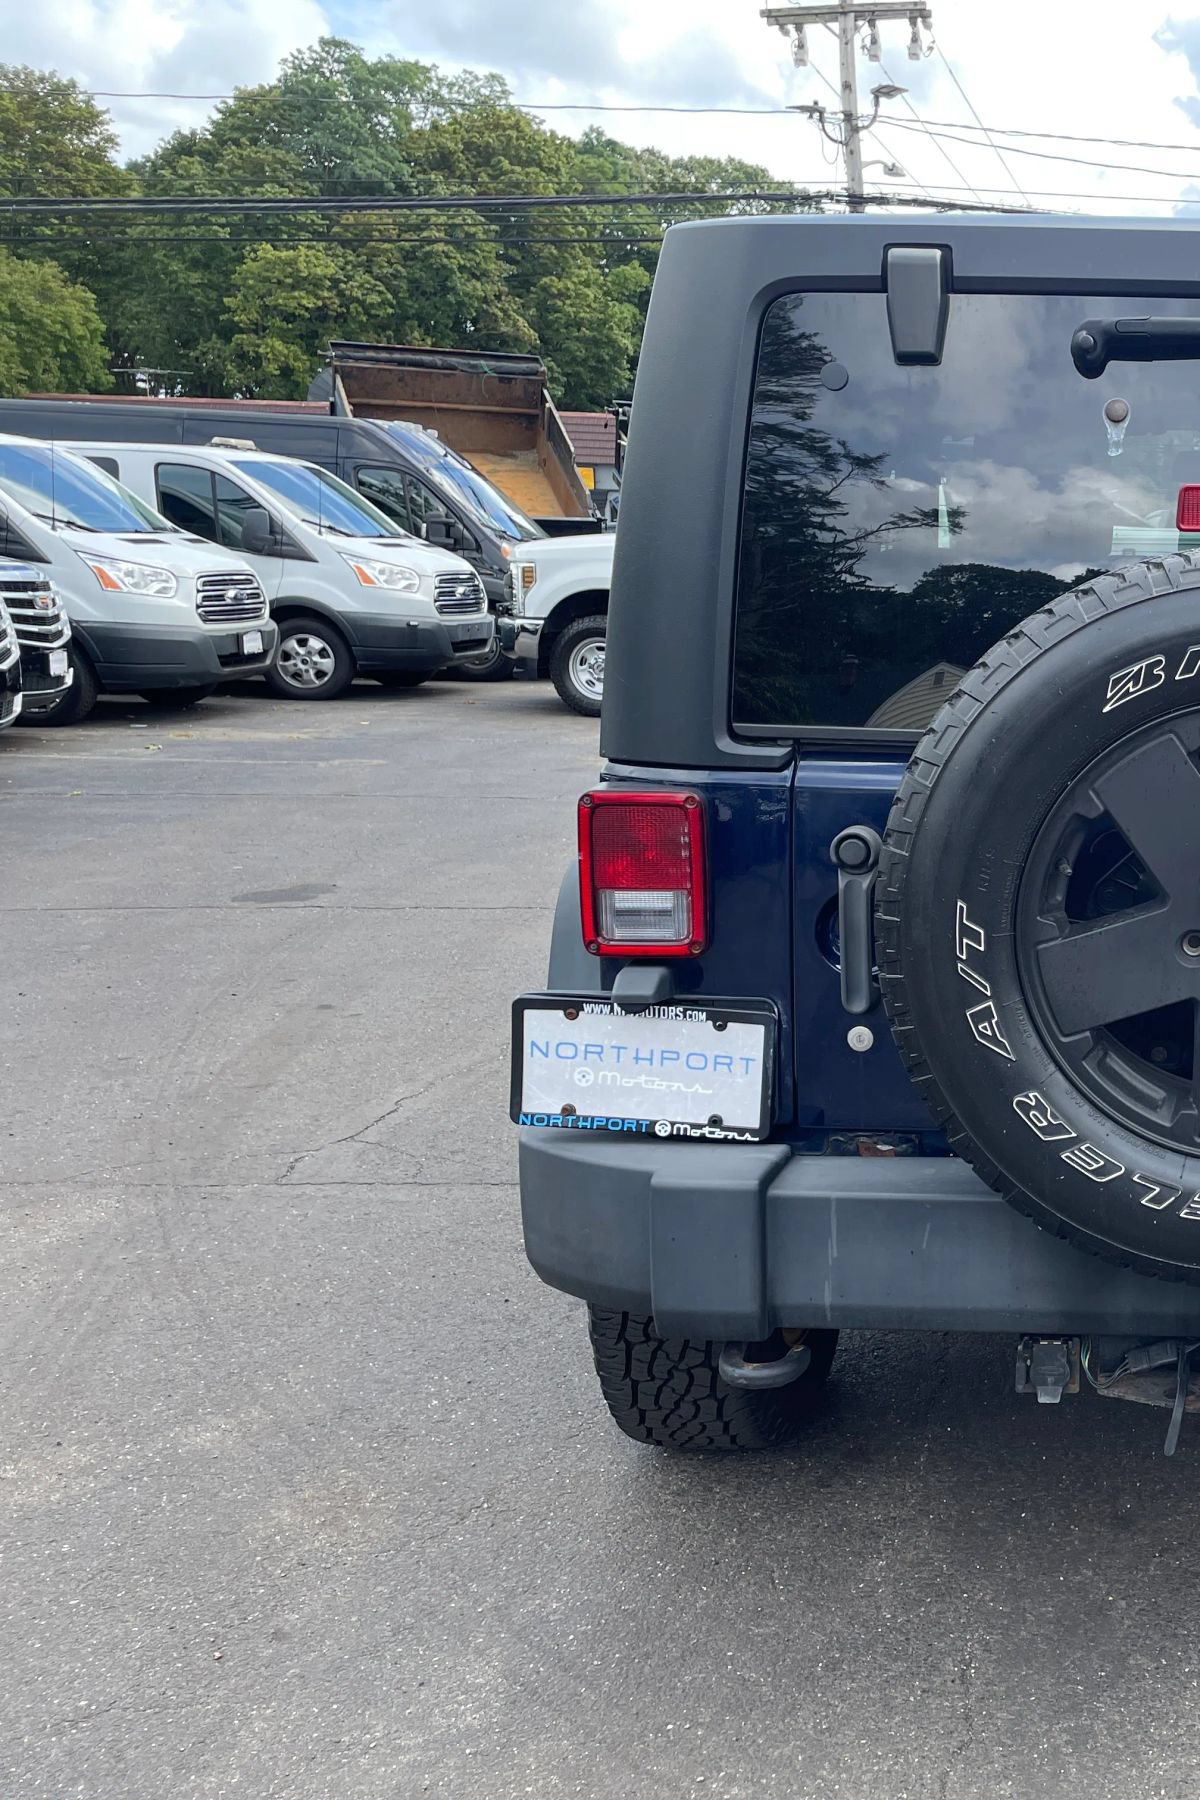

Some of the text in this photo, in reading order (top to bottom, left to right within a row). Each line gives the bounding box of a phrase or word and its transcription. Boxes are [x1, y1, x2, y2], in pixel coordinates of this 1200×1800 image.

[956, 901, 1015, 1061] A/T
[530, 1040, 756, 1075] NORTHPORT
[518, 1113, 650, 1133] NORTHPORT
